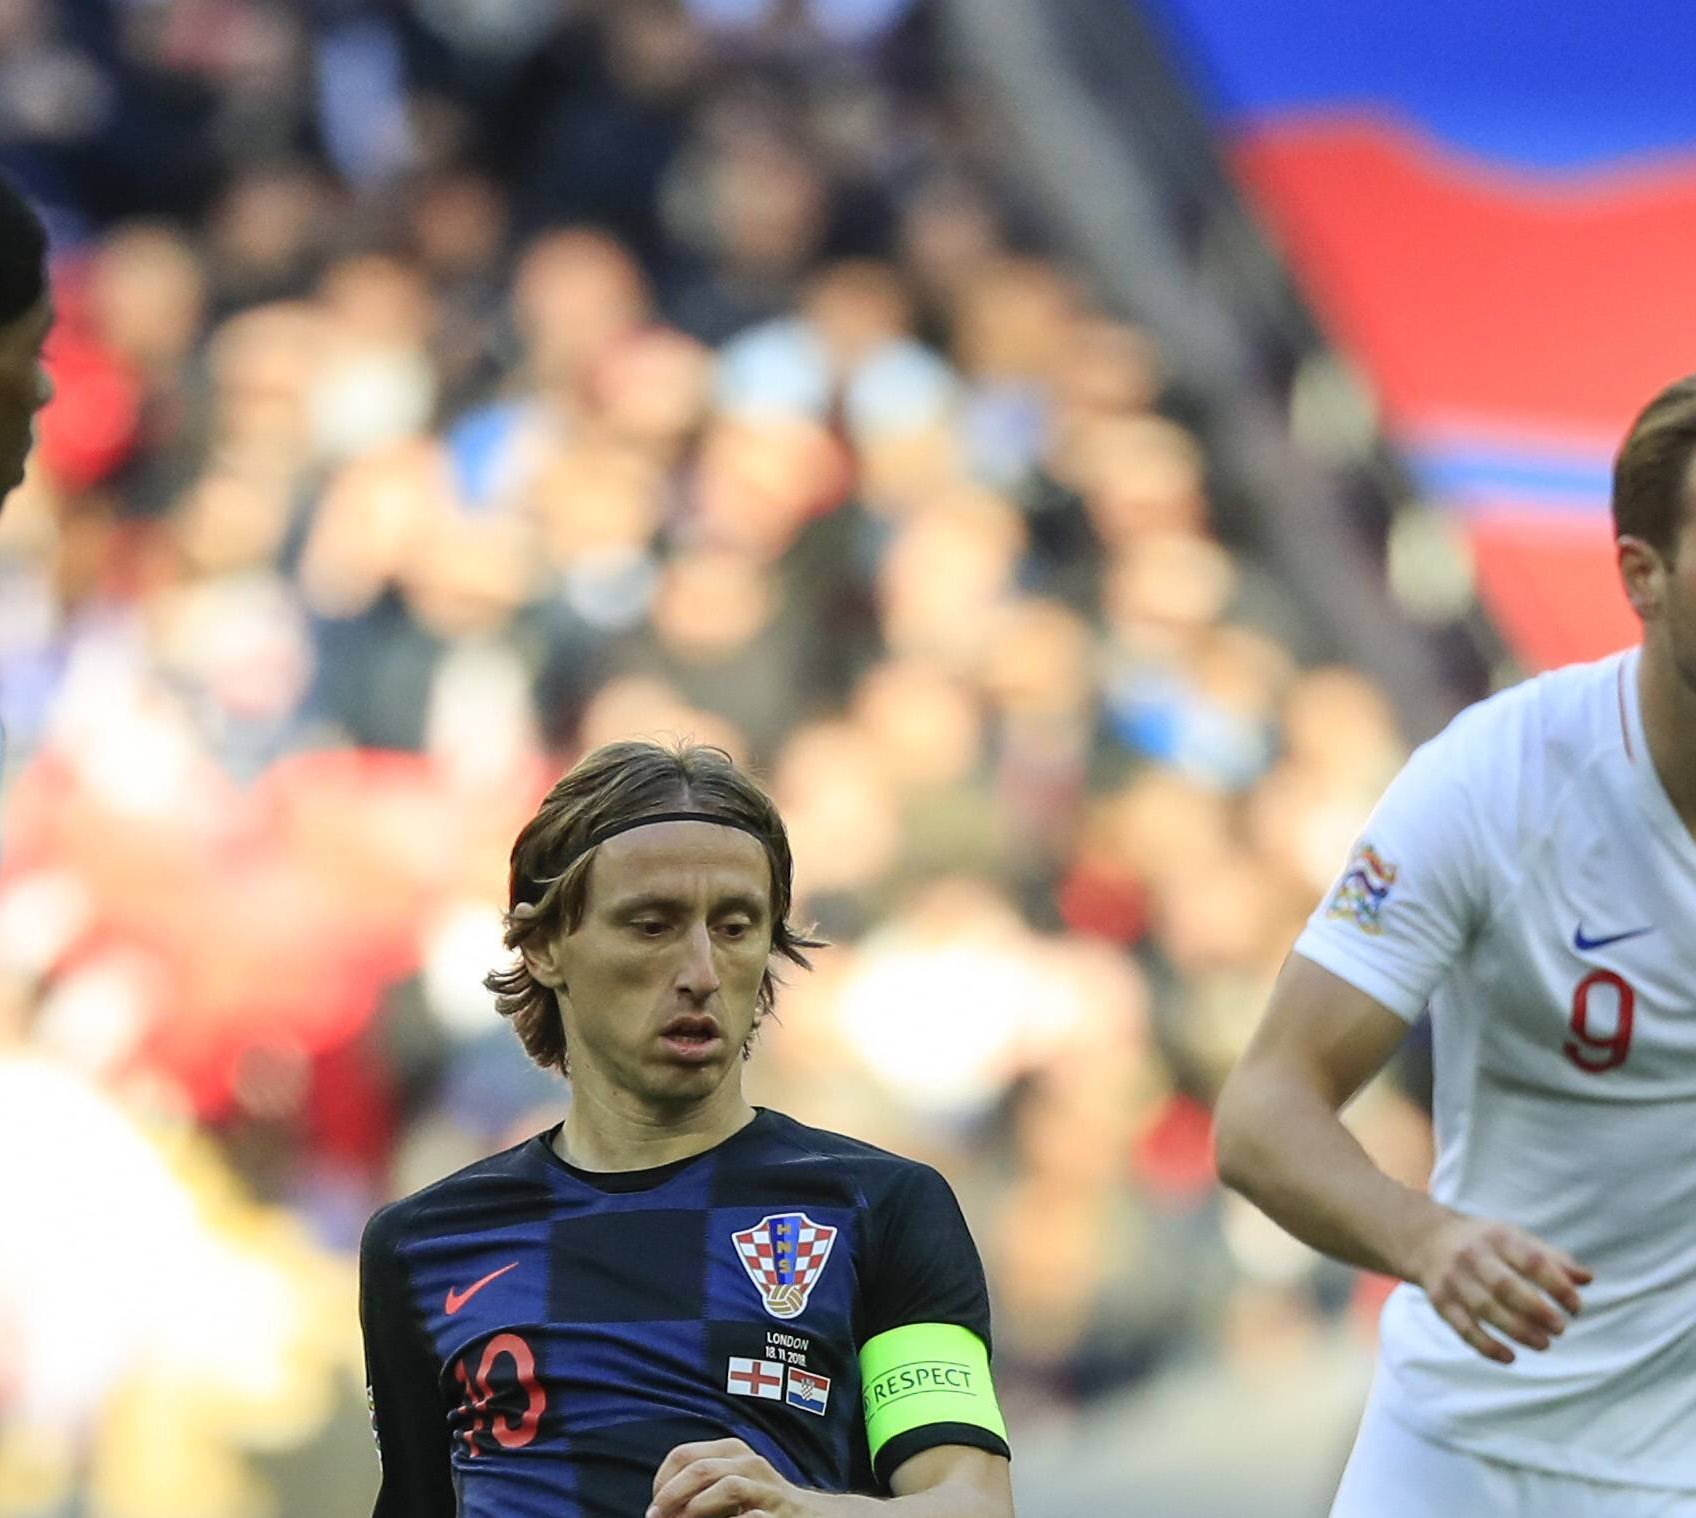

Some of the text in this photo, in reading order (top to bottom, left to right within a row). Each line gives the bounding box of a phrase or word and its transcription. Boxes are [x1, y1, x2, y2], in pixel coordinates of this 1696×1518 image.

[1563, 968, 1634, 1074] 9
[766, 1331, 810, 1351] LONDON
[454, 1332, 547, 1459] 10
[873, 1367, 972, 1403] RESPECT
